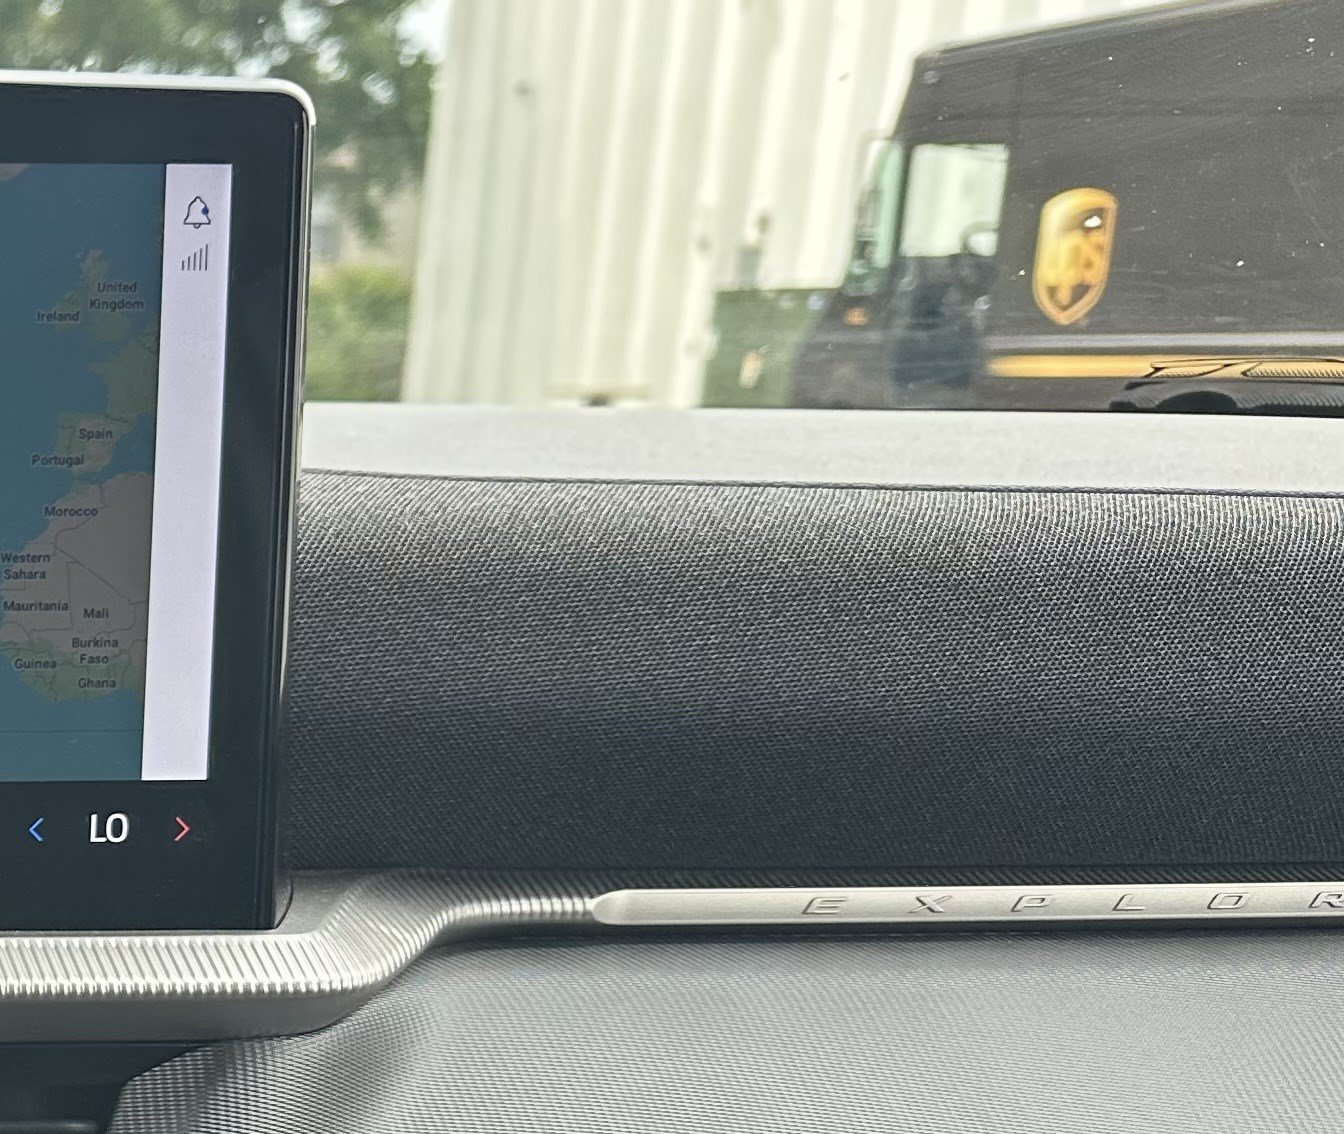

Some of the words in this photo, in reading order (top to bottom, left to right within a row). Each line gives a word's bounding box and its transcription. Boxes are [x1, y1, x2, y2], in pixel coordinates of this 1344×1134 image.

[97, 281, 138, 294] United
[89, 298, 145, 313] Kingdom
[37, 310, 80, 322] Ireland
[78, 427, 113, 442] Spain
[31, 454, 85, 468] Portugal
[43, 505, 99, 517] Morocco
[0, 552, 51, 564] Western
[3, 568, 47, 580] Sahara
[3, 600, 69, 612] Mauritania
[83, 607, 110, 619] Mali
[72, 636, 119, 649] Burkina
[14, 658, 57, 670] Guinea
[79, 653, 110, 665] Faso
[77, 677, 117, 689] Ghana
[88, 814, 129, 844] LO
